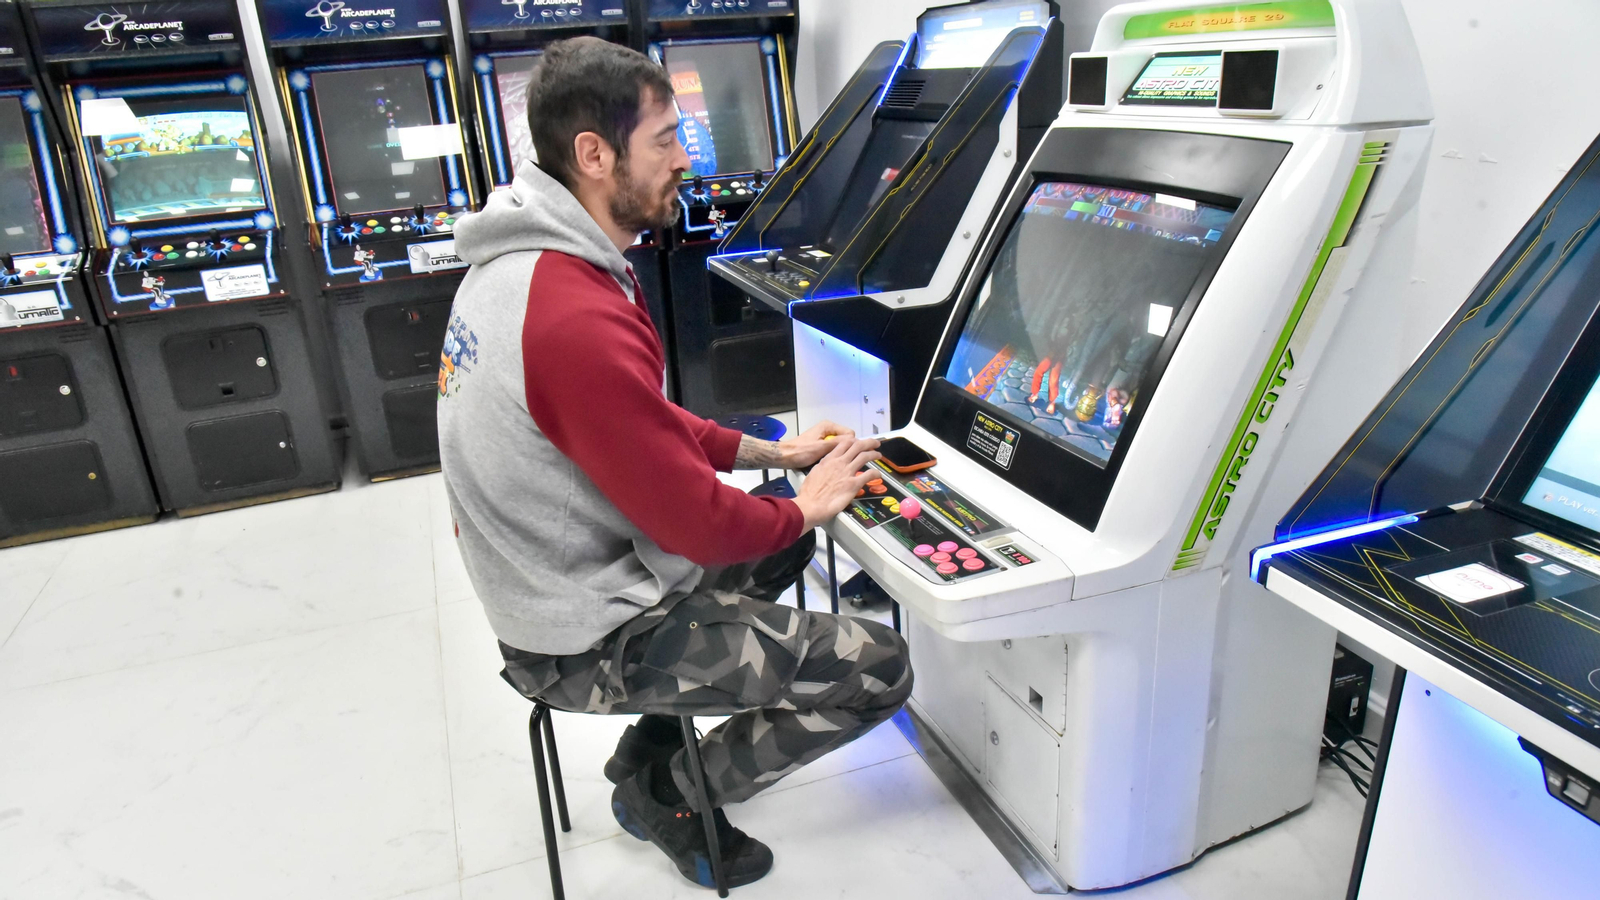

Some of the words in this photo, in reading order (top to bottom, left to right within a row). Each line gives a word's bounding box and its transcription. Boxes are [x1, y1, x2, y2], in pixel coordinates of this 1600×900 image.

[340, 9, 395, 18] ARCADEPLANET
[122, 21, 183, 31] ARCADEPLANET
[1168, 20, 1195, 29] FLAT
[1202, 15, 1257, 26] SQUARE
[1171, 65, 1210, 77] NEW
[1134, 79, 1189, 90] ASTRO
[1189, 79, 1219, 90] CIT
[1202, 431, 1260, 541] ASTRO
[1255, 347, 1295, 424] CITY
[1557, 494, 1585, 510] PLAY
